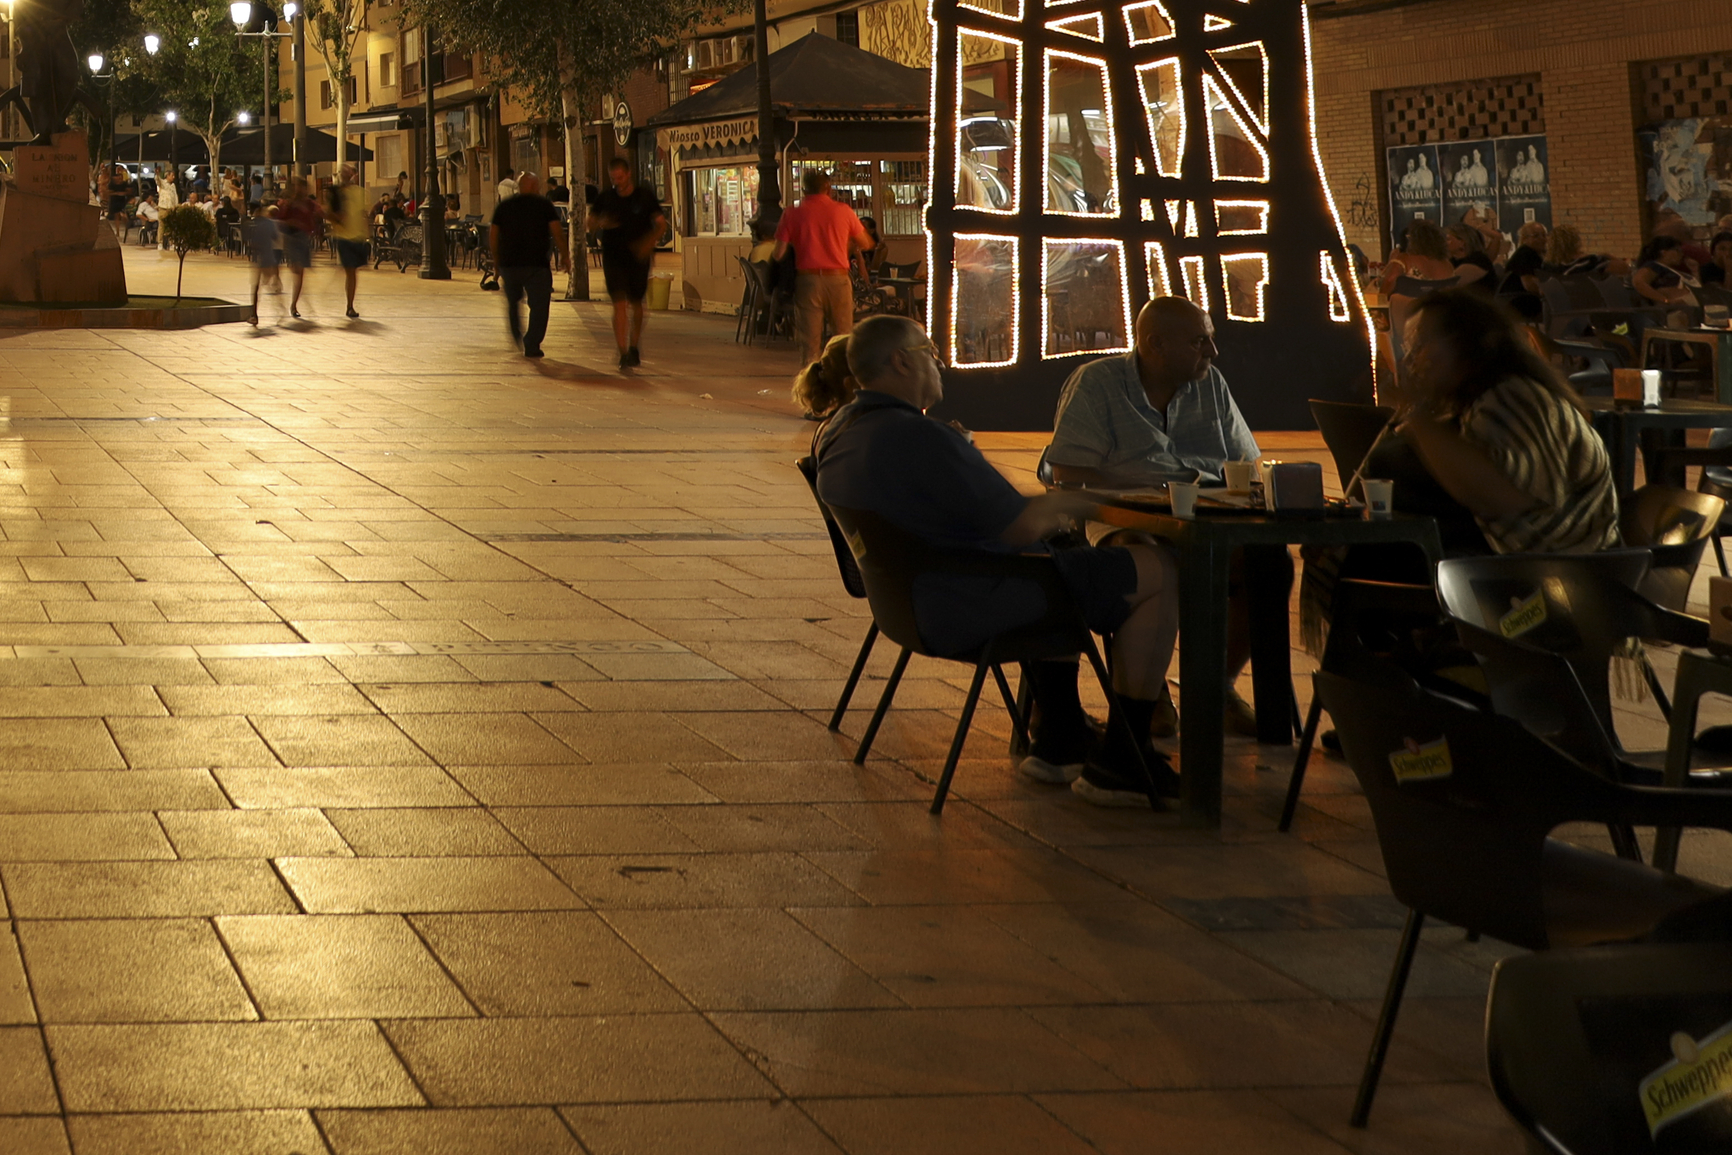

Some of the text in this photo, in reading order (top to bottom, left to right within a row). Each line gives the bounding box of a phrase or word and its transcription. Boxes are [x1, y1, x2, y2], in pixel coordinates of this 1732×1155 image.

[702, 121, 755, 140] VERONICA
[1502, 604, 1543, 634] Schweppes
[1393, 752, 1448, 776] Schweppes
